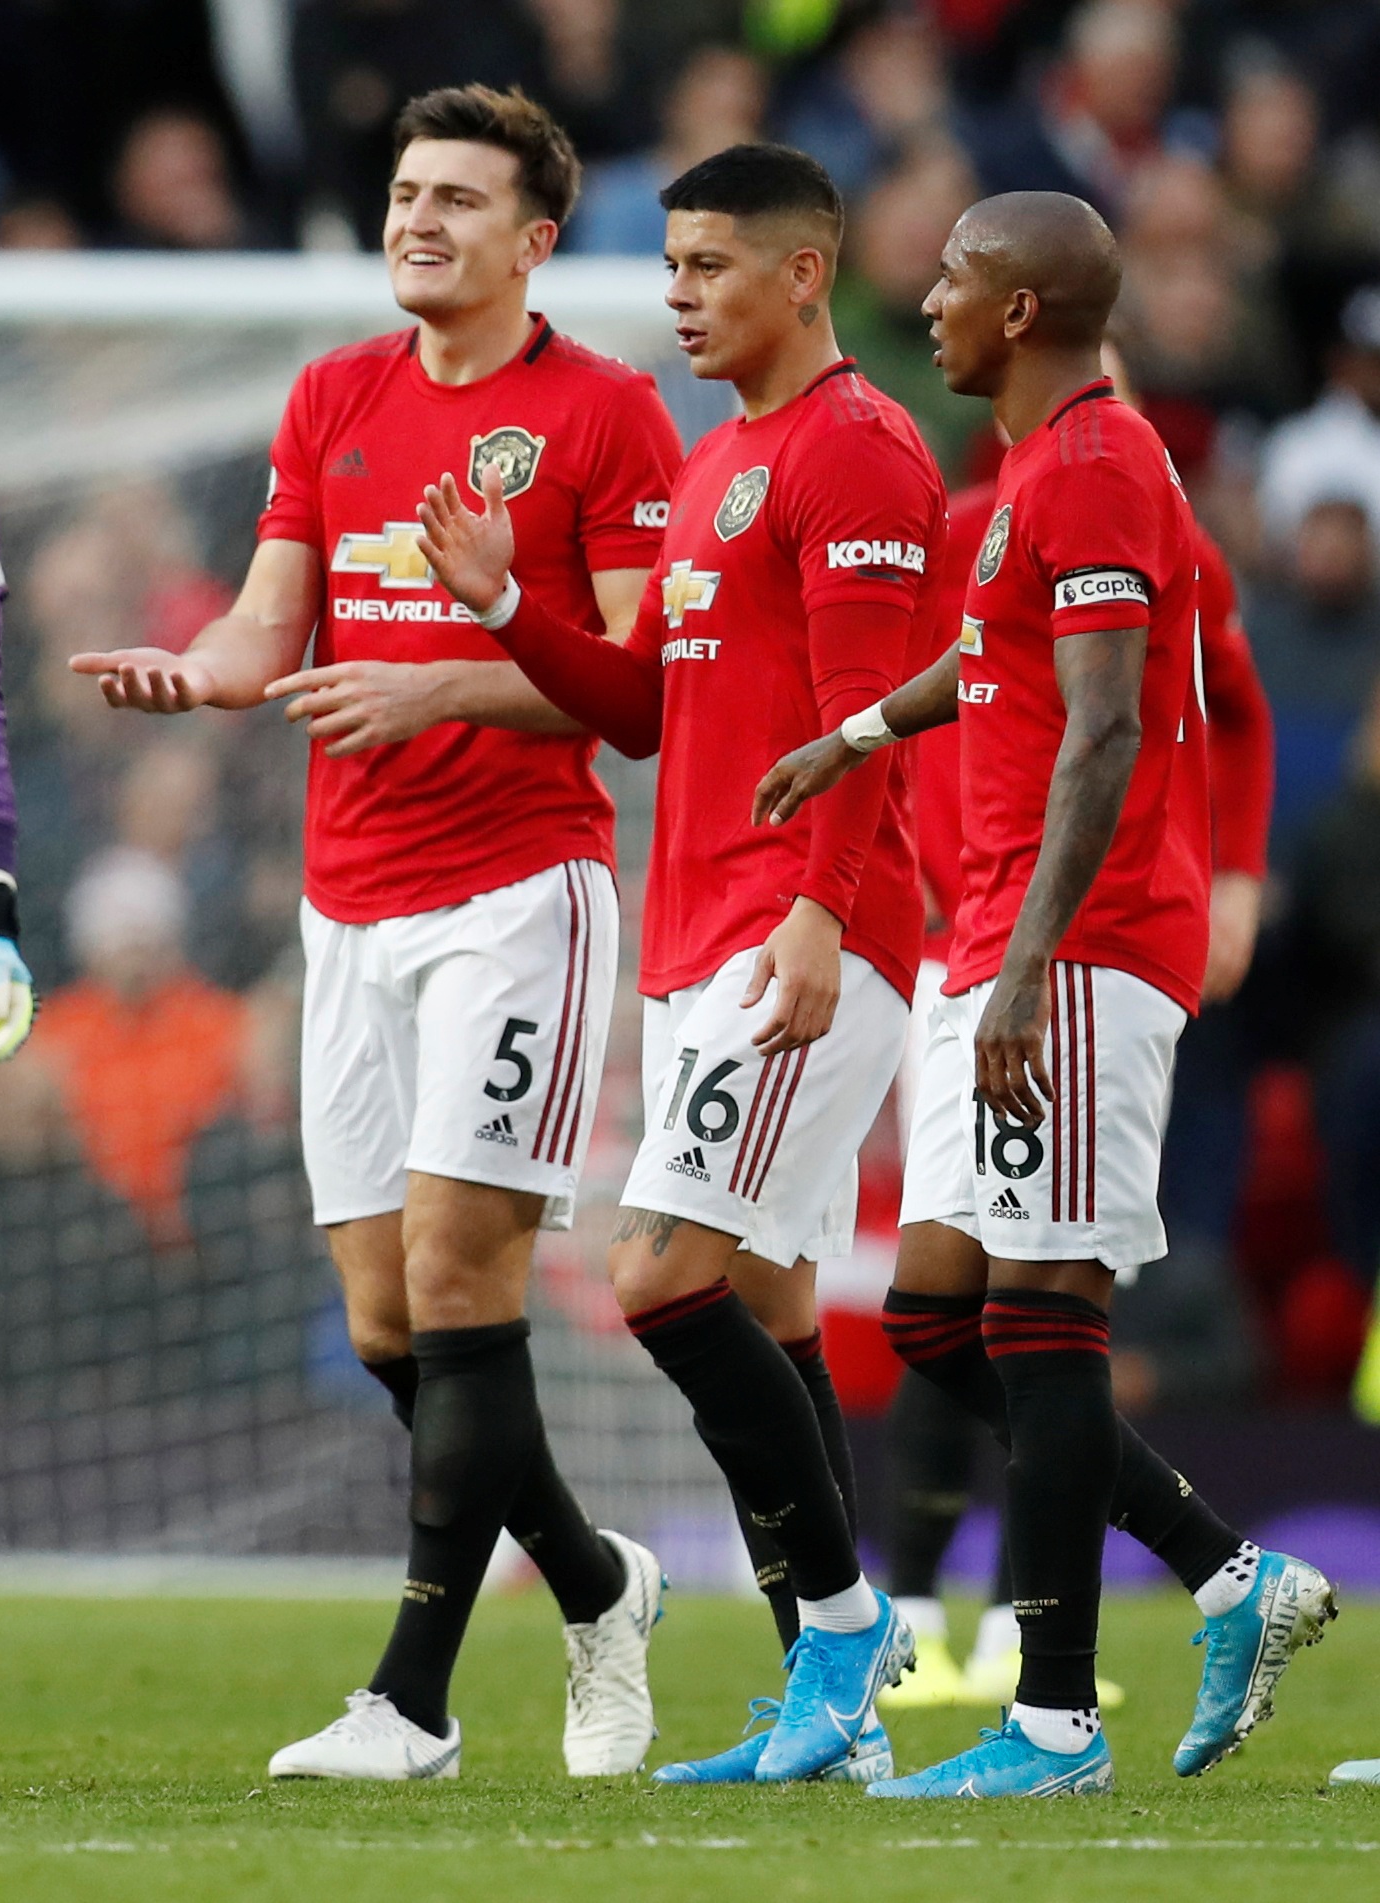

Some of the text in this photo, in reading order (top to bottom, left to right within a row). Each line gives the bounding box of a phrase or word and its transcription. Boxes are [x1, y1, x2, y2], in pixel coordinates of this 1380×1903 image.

[827, 540, 926, 574] KOHLER
[334, 598, 481, 623] CHEVROLE
[483, 1017, 539, 1102] 5
[663, 1047, 744, 1143] 16
[972, 1087, 1044, 1179] 18
[665, 1161, 711, 1183] adidas
[989, 1207, 1030, 1220] adidas
[1258, 1577, 1279, 1620] MERC
